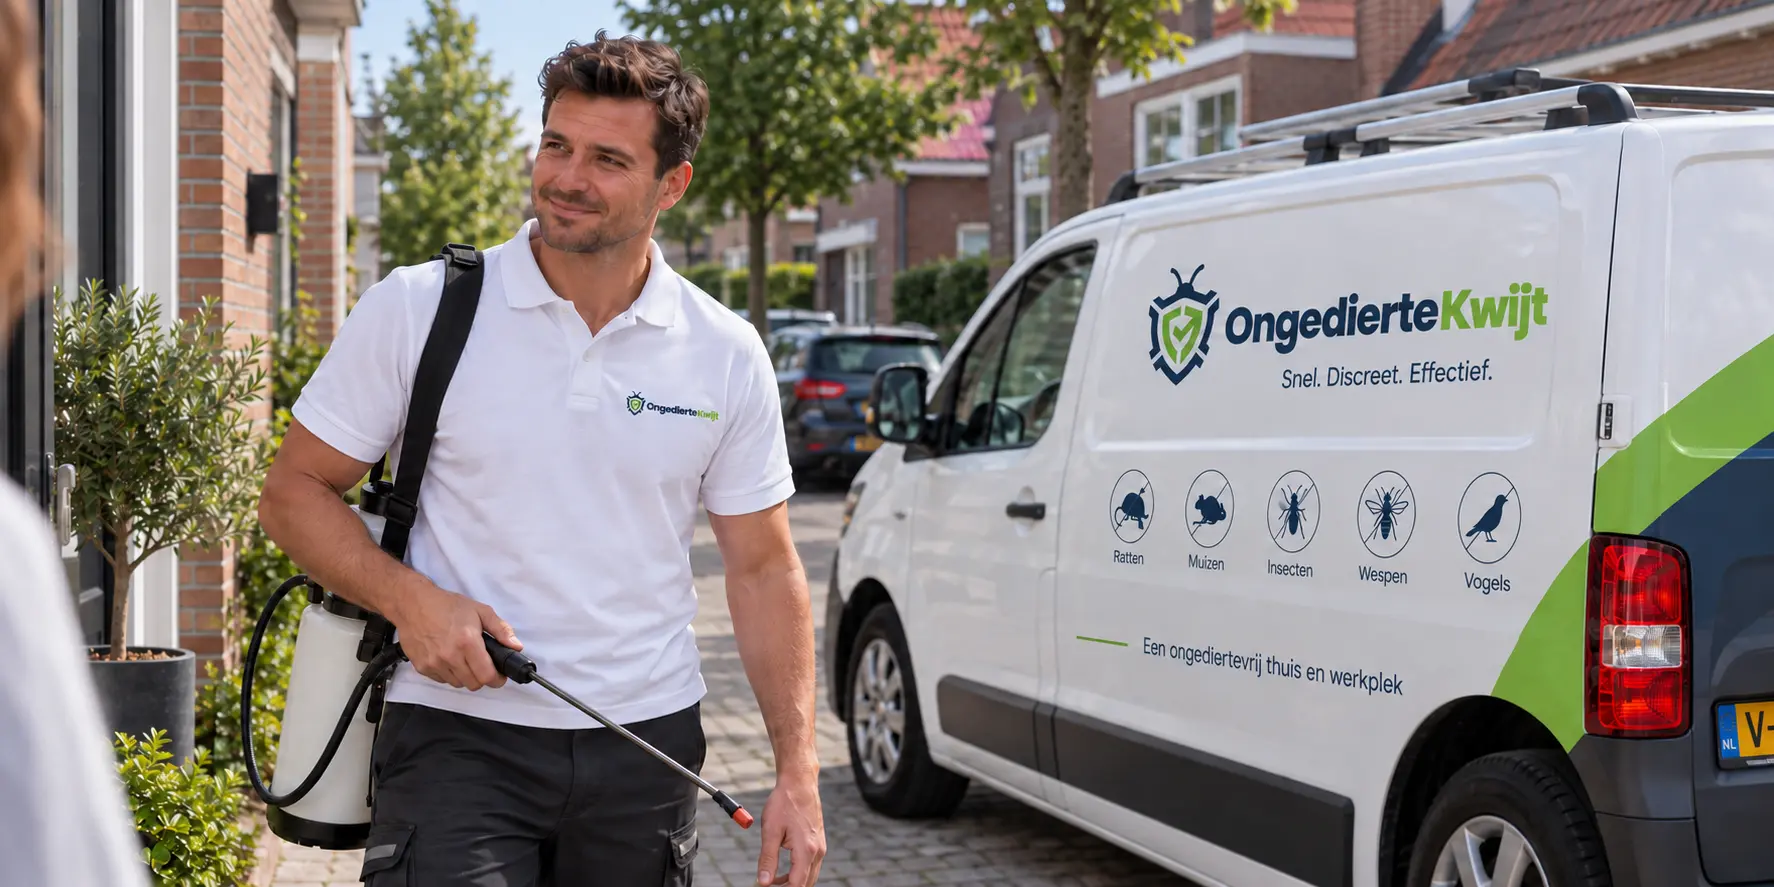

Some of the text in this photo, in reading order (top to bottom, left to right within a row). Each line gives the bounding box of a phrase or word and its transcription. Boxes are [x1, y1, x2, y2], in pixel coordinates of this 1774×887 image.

[1225, 282, 1548, 354] OngedierteKwijt
[1282, 359, 1493, 389] Snel. Discreet. Effectief.
[646, 402, 719, 422] OngedierteKwijt
[1113, 550, 1144, 565] Ratten
[1188, 554, 1225, 571] Muizen
[1267, 560, 1314, 578] Insecten
[1358, 566, 1408, 587] Wespen
[1464, 572, 1511, 596] Vogels
[1143, 637, 1404, 696] Een ongediertevrij thuis en werkplek
[1722, 738, 1737, 750] NL
